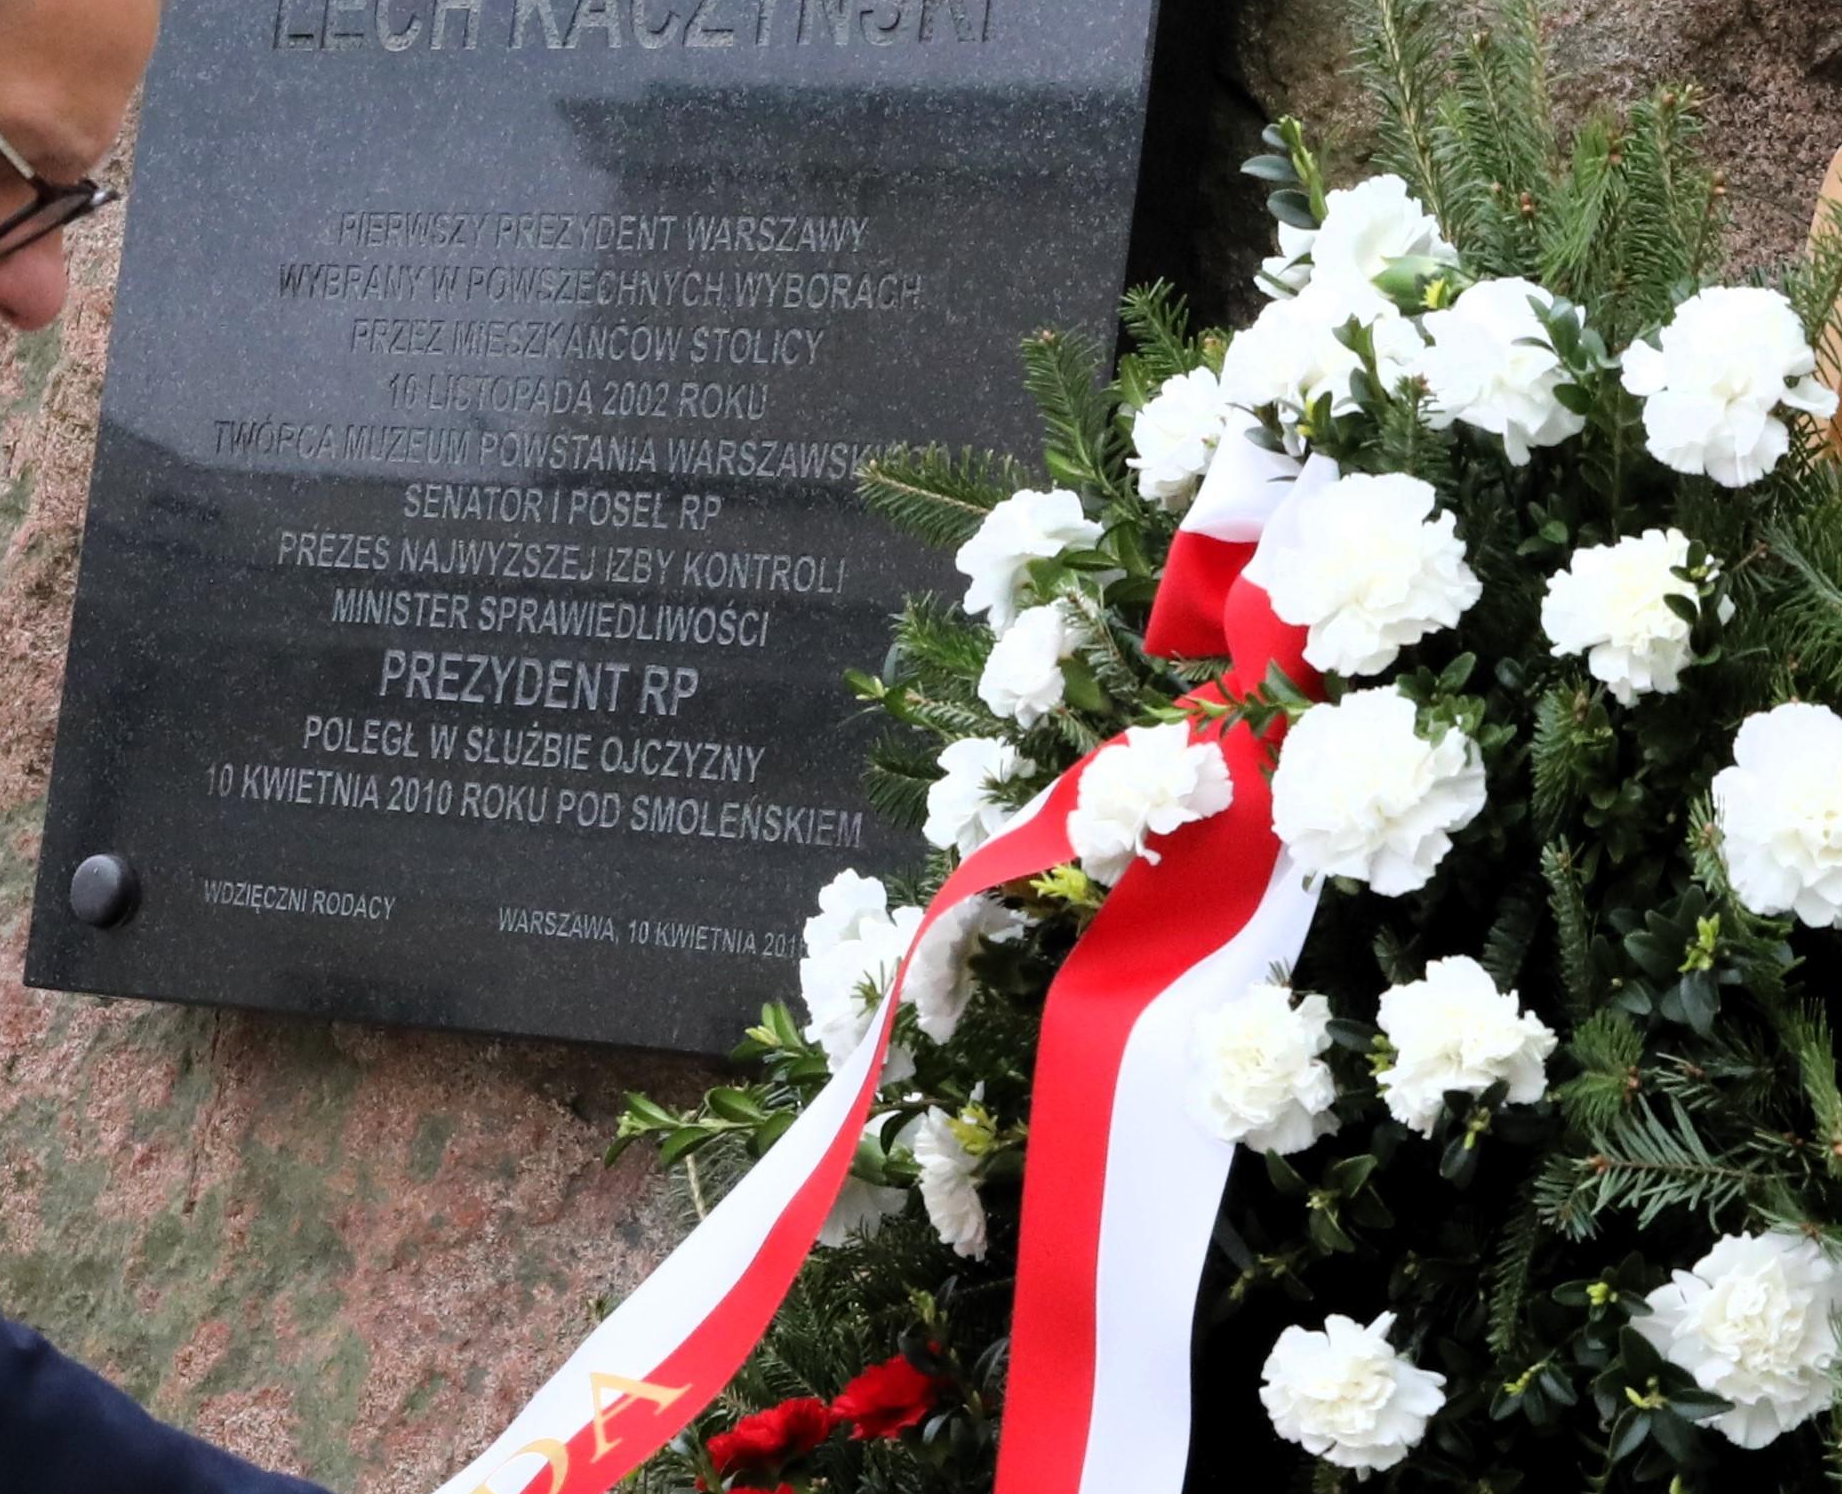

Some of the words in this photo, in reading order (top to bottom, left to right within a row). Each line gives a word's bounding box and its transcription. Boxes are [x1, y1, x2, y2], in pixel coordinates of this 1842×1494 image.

[337, 210, 489, 249] PIERWSZY
[494, 212, 678, 252] PREZYDENT
[685, 213, 870, 254] WARSZAWY
[278, 262, 426, 303] WYBRANY
[432, 264, 460, 305] W
[465, 265, 724, 309] POWSZECHNYCH
[734, 269, 924, 310] WYBORACH
[350, 317, 447, 356] PRZEZ
[452, 316, 683, 362] MIESZKAŃCÓW
[689, 325, 826, 366] STOLICY
[388, 372, 416, 410] 10
[428, 373, 594, 415] LISTOPADA
[602, 379, 670, 418] 2002
[677, 380, 770, 421] ROKU
[213, 413, 336, 460] TWÓRCA
[343, 423, 473, 465] MUZEUM
[479, 429, 657, 473] POWSTANIA
[403, 483, 543, 524] SENATOR
[550, 488, 561, 525] I
[567, 489, 668, 529] POSEŁ
[678, 493, 723, 532] RP
[276, 530, 391, 571] PREZES
[398, 533, 595, 583] NAJWYŻSZEJ
[604, 546, 676, 586] IZBY
[682, 549, 847, 594] KONTROLI
[331, 587, 470, 630] MINISTER
[477, 595, 771, 648] SPRAWIEDLIWOŚCI
[378, 648, 631, 713] PREZYDENT
[639, 663, 699, 717] RP
[302, 714, 420, 759] POLEGŁ
[429, 723, 458, 761] W
[463, 720, 593, 771] SŁUŻBIE
[600, 735, 766, 784] OJCZYZNY
[205, 762, 235, 798] 10
[240, 763, 381, 810] KWIETNIA
[386, 775, 454, 816] 2010
[459, 781, 549, 824] ROKU
[555, 788, 623, 829] POD
[629, 793, 865, 849] SMOLEŃSKIEM
[203, 879, 308, 915] WDZIĘCZNI
[312, 887, 397, 921] RODACY
[497, 905, 620, 946] WARSZAWA,
[628, 920, 650, 945] 10
[656, 922, 757, 956] KWIETNIA
